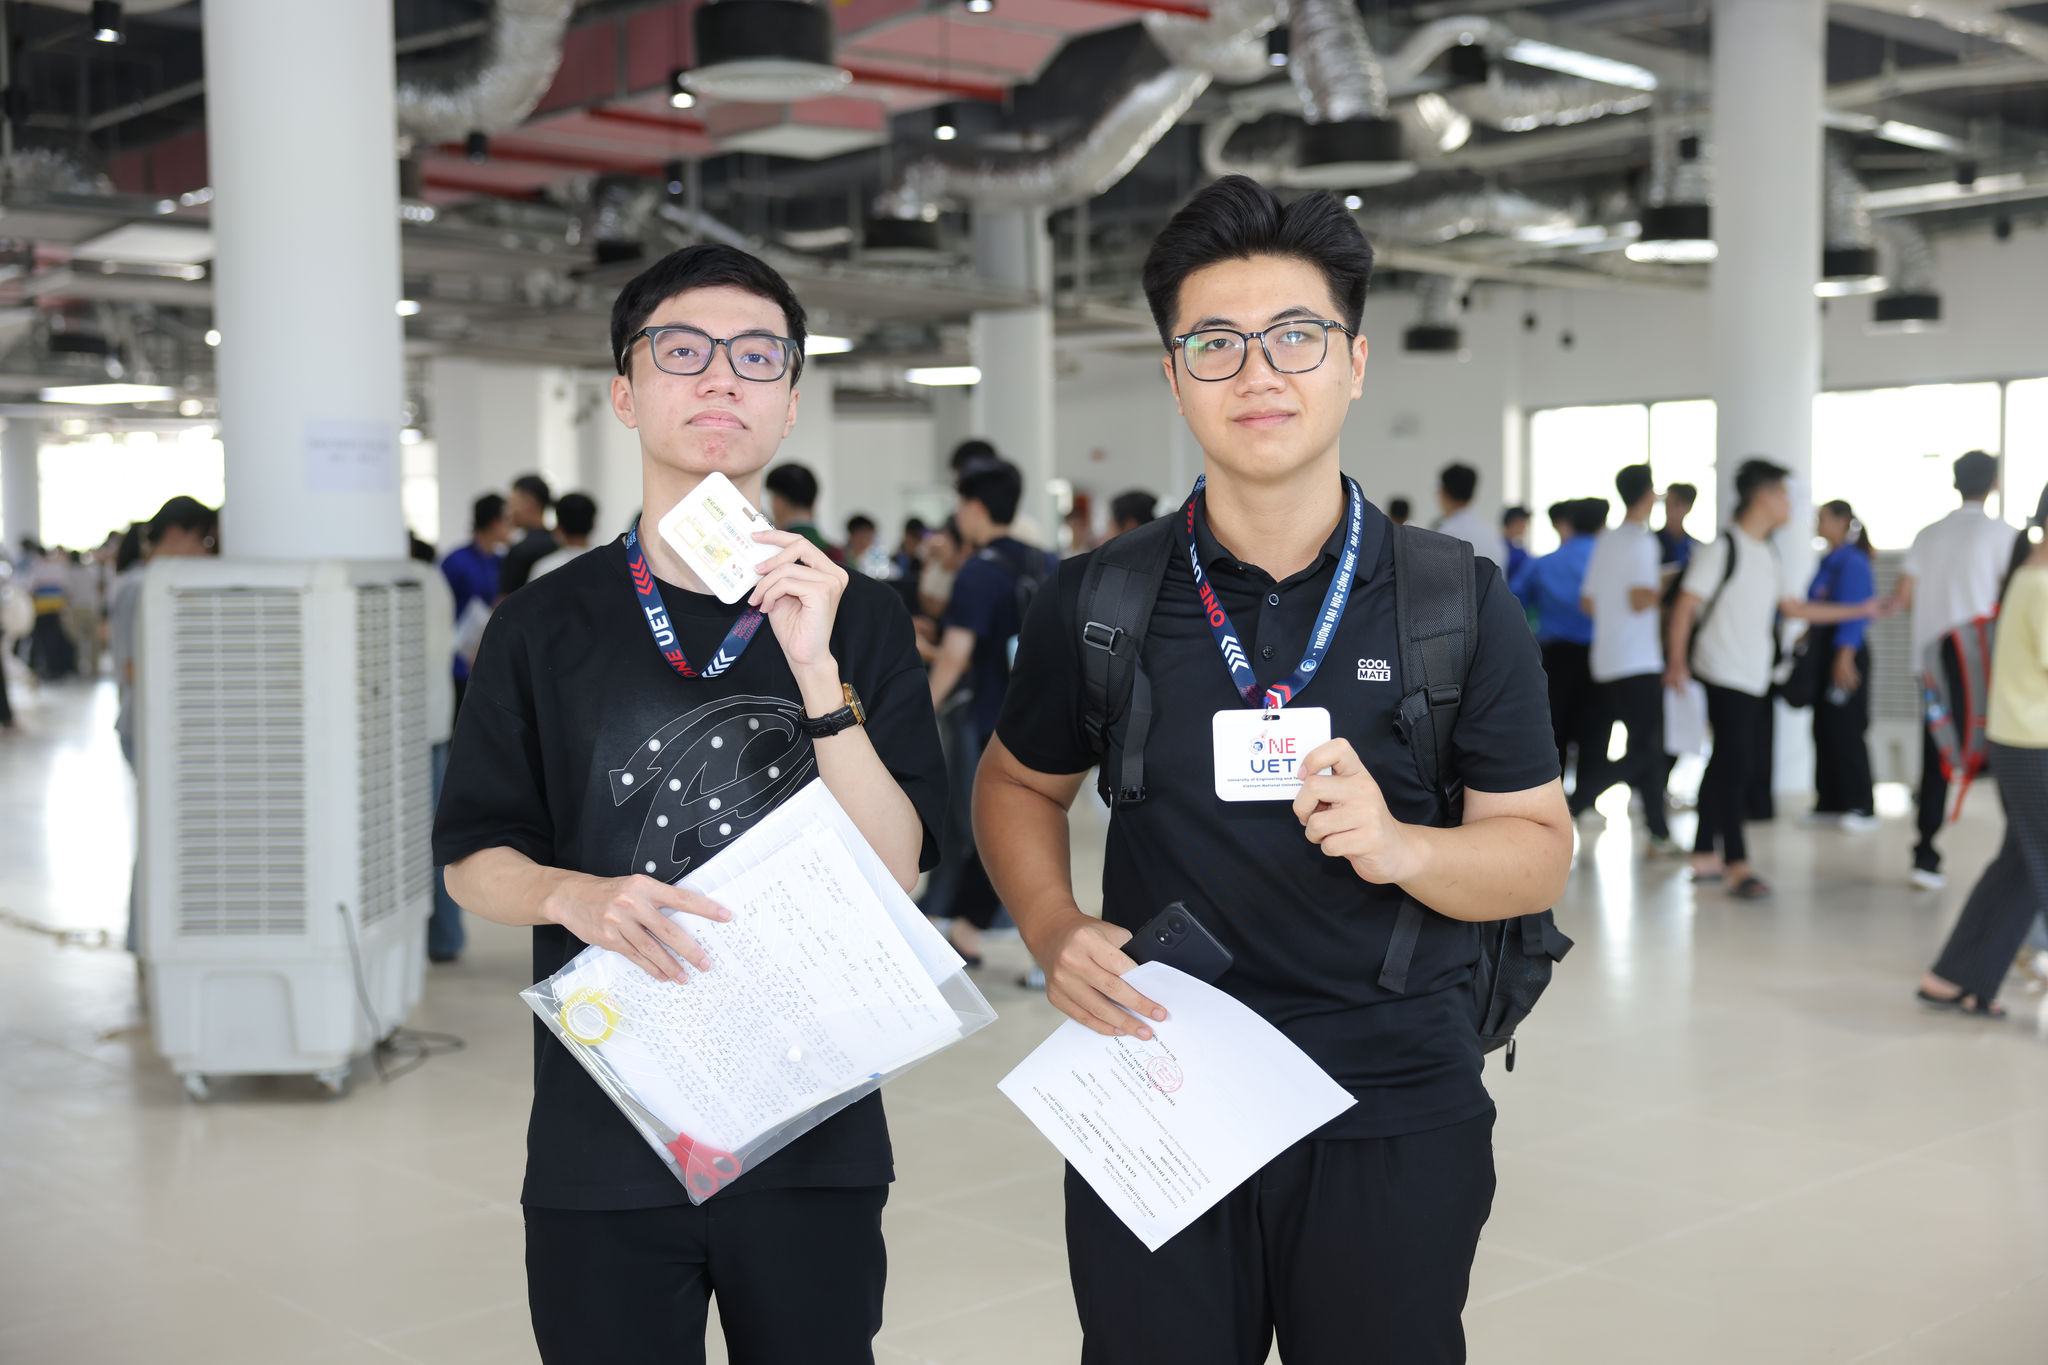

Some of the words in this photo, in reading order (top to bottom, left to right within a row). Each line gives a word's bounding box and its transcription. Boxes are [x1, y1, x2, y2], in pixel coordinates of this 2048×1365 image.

[1188, 541, 1203, 585] UET
[1343, 550, 1358, 572] NGHỆ
[1336, 570, 1351, 592] CÔNG
[1199, 581, 1225, 628] ONE
[1330, 591, 1345, 608] HỌC
[645, 604, 676, 648] UET
[1325, 608, 1339, 623] ĐẠI
[1313, 620, 1333, 650] TRƯỜNG
[665, 650, 698, 678] ONE
[1357, 658, 1390, 669] COOL
[1359, 670, 1388, 679] MATE
[1250, 758, 1296, 773] UET
